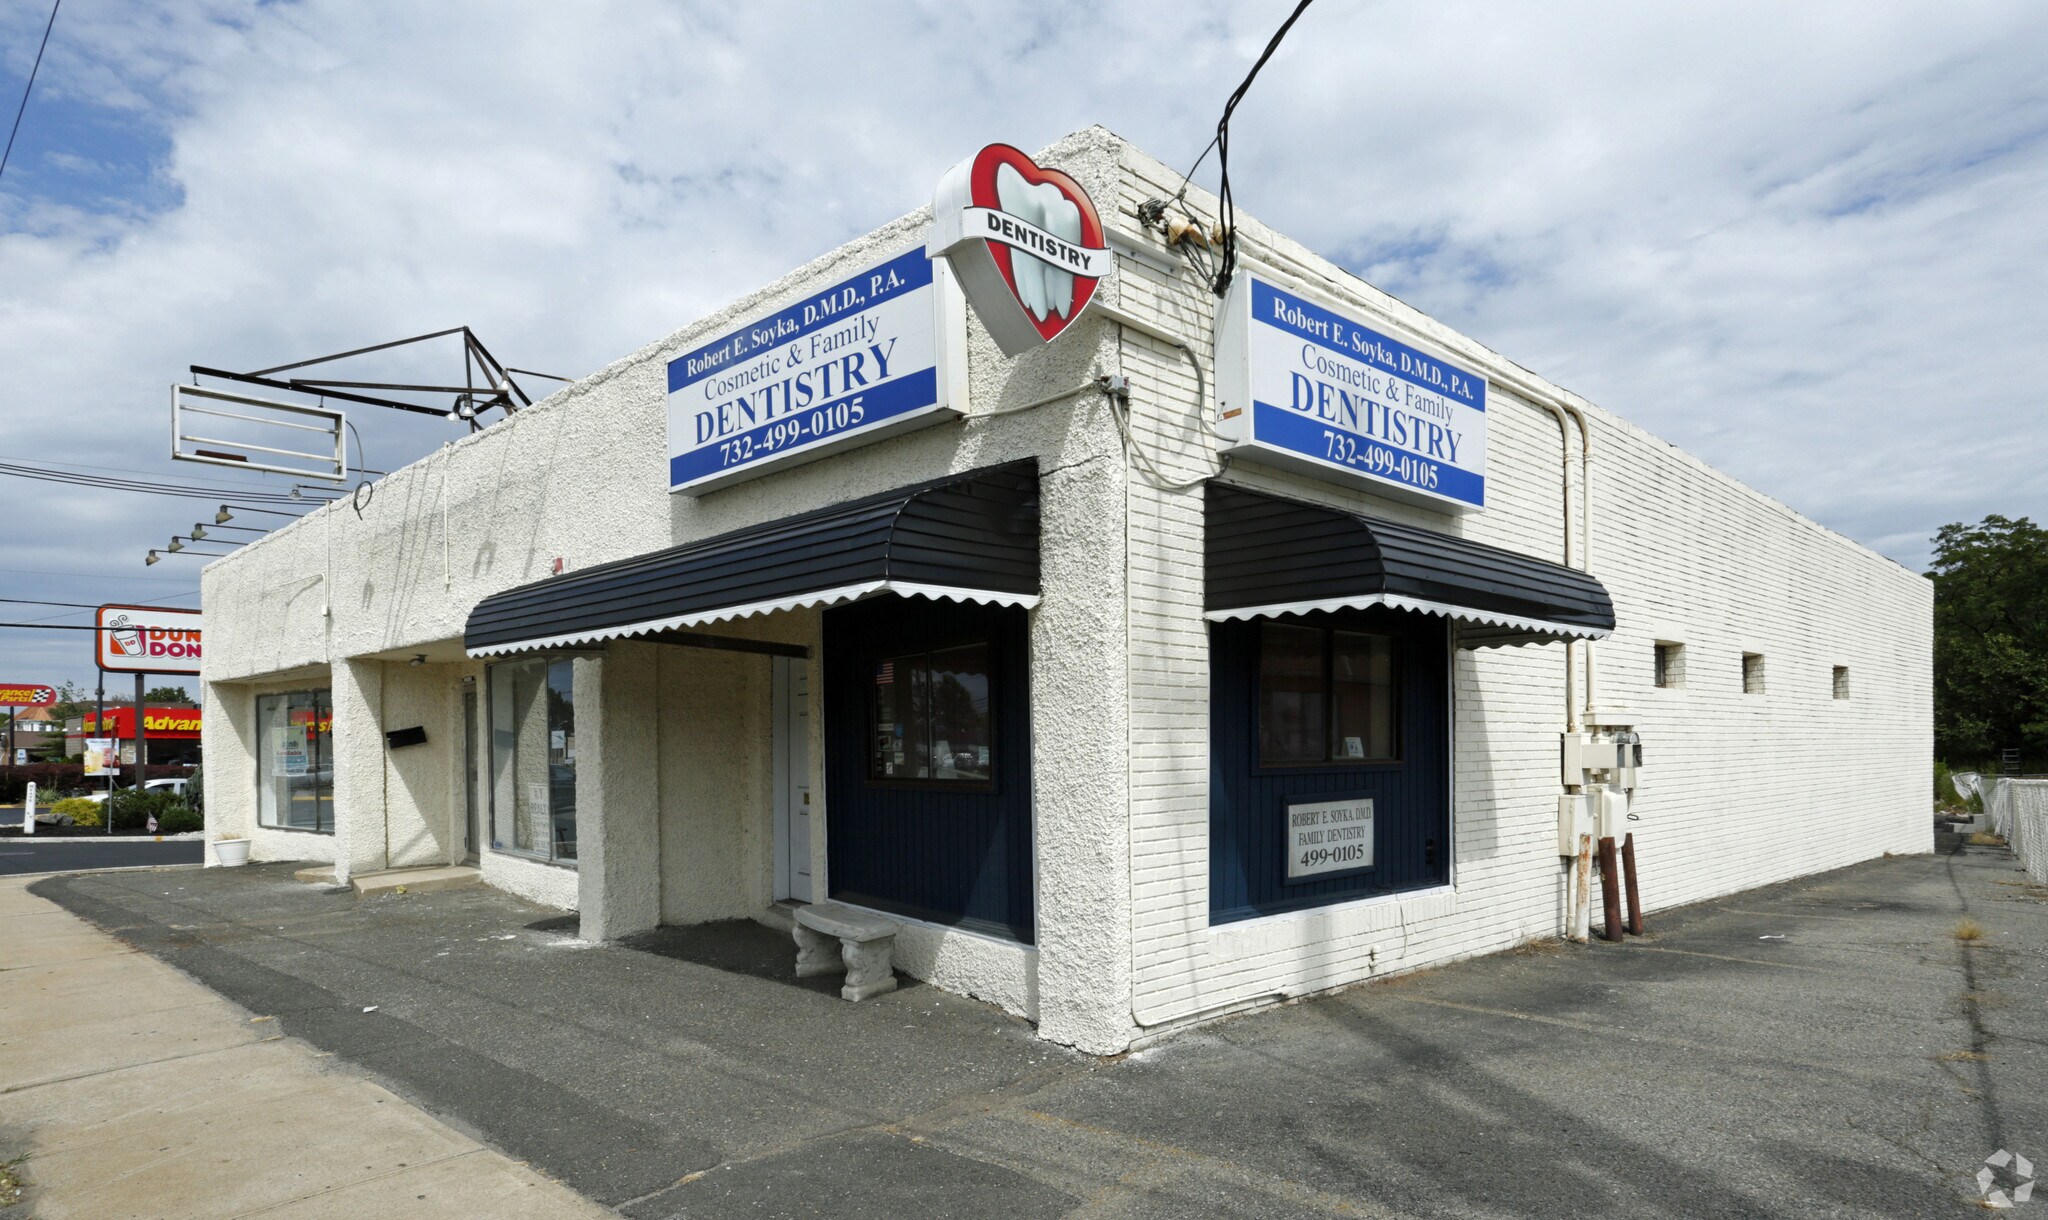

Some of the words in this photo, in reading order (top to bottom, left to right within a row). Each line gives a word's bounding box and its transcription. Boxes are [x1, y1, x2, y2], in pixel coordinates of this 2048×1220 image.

[987, 211, 1092, 271] DENTISTRY
[686, 346, 730, 378] Robert
[733, 335, 748, 357] E.
[751, 318, 799, 350] Soyka,
[803, 286, 865, 327] D.M.D.,
[870, 268, 906, 297] P.A.
[704, 354, 781, 401] Cosmetic
[786, 343, 804, 366] &
[809, 314, 880, 359] Family
[1273, 296, 1329, 339] Robert
[1332, 322, 1348, 347] E.
[1351, 331, 1397, 371] Soyka,
[1400, 351, 1448, 392] D.M.D.,
[1451, 374, 1474, 400] P.A.
[694, 336, 898, 446] DENTISTRY
[1289, 370, 1463, 464] DENTISTRY
[1301, 343, 1380, 395] Cosmetic
[1385, 377, 1400, 403] &
[1404, 383, 1454, 428] Family
[719, 395, 865, 467] 732-499-0105
[1322, 429, 1439, 489] 732-499-0105
[1292, 811, 1320, 828] ROBERT
[1298, 830, 1325, 847] FAMILY
[1327, 825, 1366, 843] DENTISTRY
[1300, 843, 1364, 867] 499-0105
